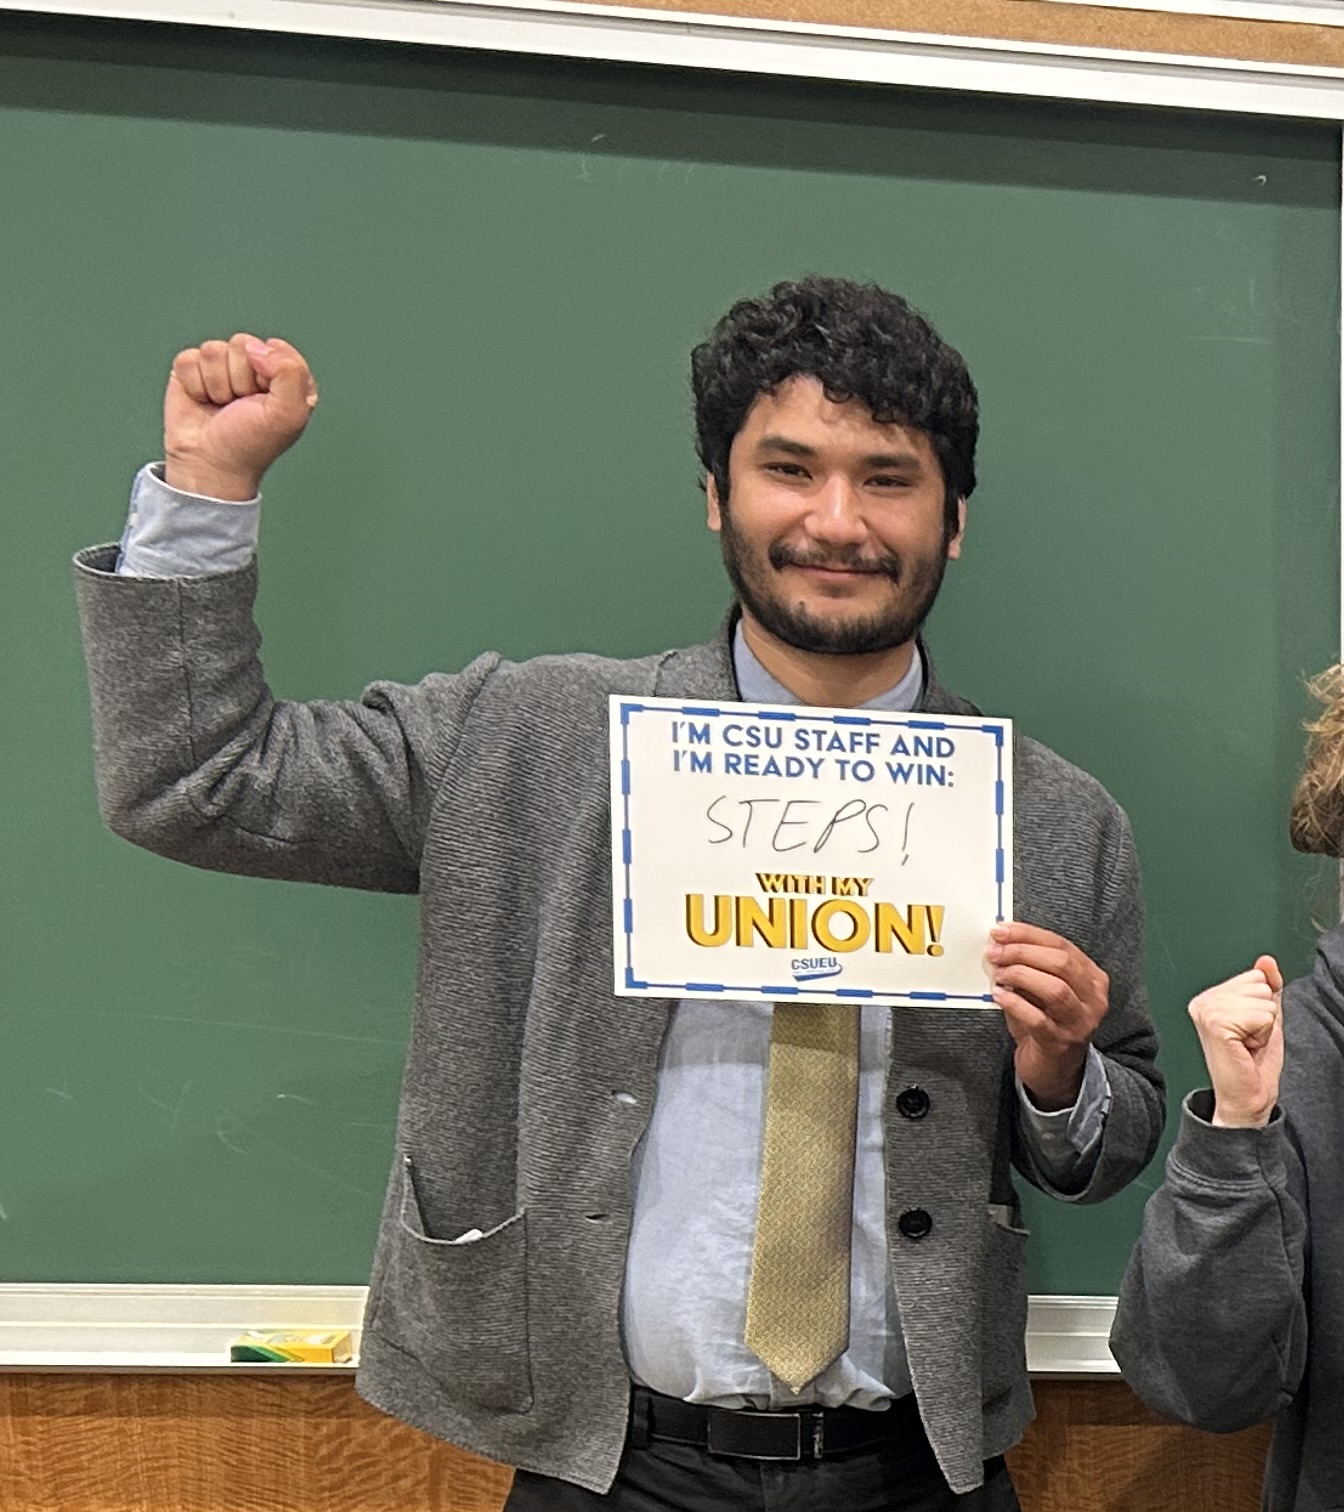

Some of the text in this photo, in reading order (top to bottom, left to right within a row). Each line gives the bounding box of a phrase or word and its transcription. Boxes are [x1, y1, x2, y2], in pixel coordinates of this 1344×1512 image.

[671, 721, 956, 758] I'M CSU STAFF AND
[673, 749, 955, 788] I'M READY TO WIN:
[706, 795, 915, 866] STEPS!
[755, 872, 875, 897] WITH MY
[684, 893, 946, 958] UNION!
[790, 956, 838, 972] CSUEU
